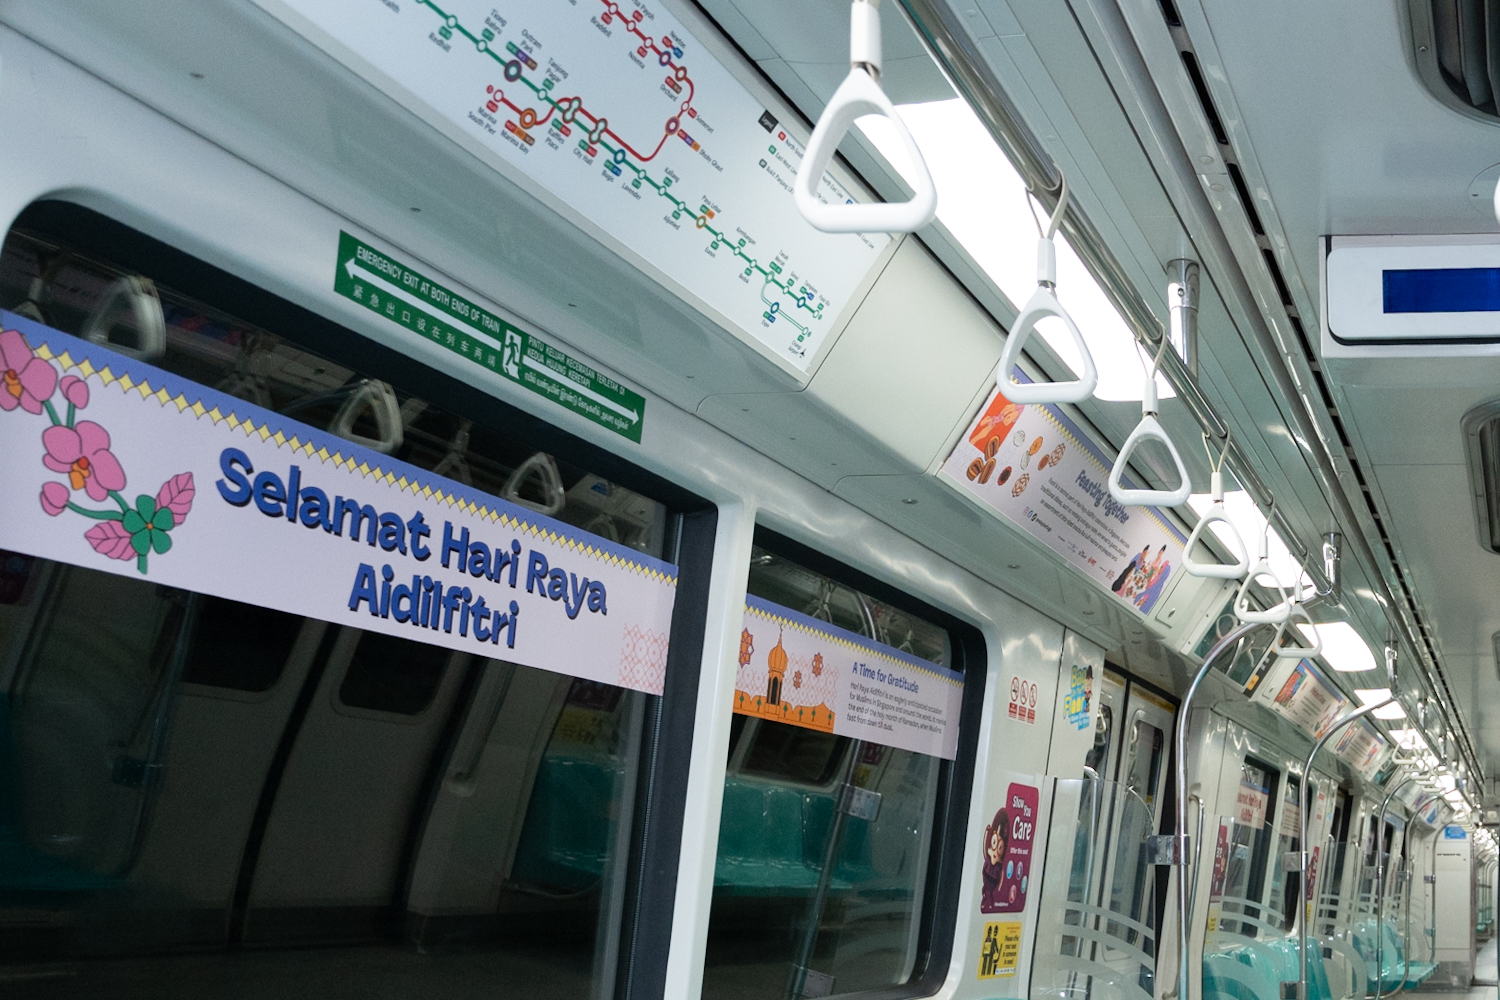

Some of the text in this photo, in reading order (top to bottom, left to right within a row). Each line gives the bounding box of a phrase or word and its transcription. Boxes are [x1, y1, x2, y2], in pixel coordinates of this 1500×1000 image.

[356, 244, 501, 334] EMERGENCY EXIT AT BOTH ENDS OF TRAIN
[352, 284, 496, 370] 紧急出口设在列车两端
[619, 384, 626, 396] DI
[1075, 469, 1107, 508] Feasting
[1102, 492, 1130, 524] Together
[215, 447, 609, 622] Selamat Hari Raya
[348, 562, 520, 650] Aidilfitri
[852, 662, 919, 693] A Time for Gratitude
[1012, 795, 1025, 809] Show
[1023, 804, 1032, 817] You
[1012, 816, 1032, 840] Care
